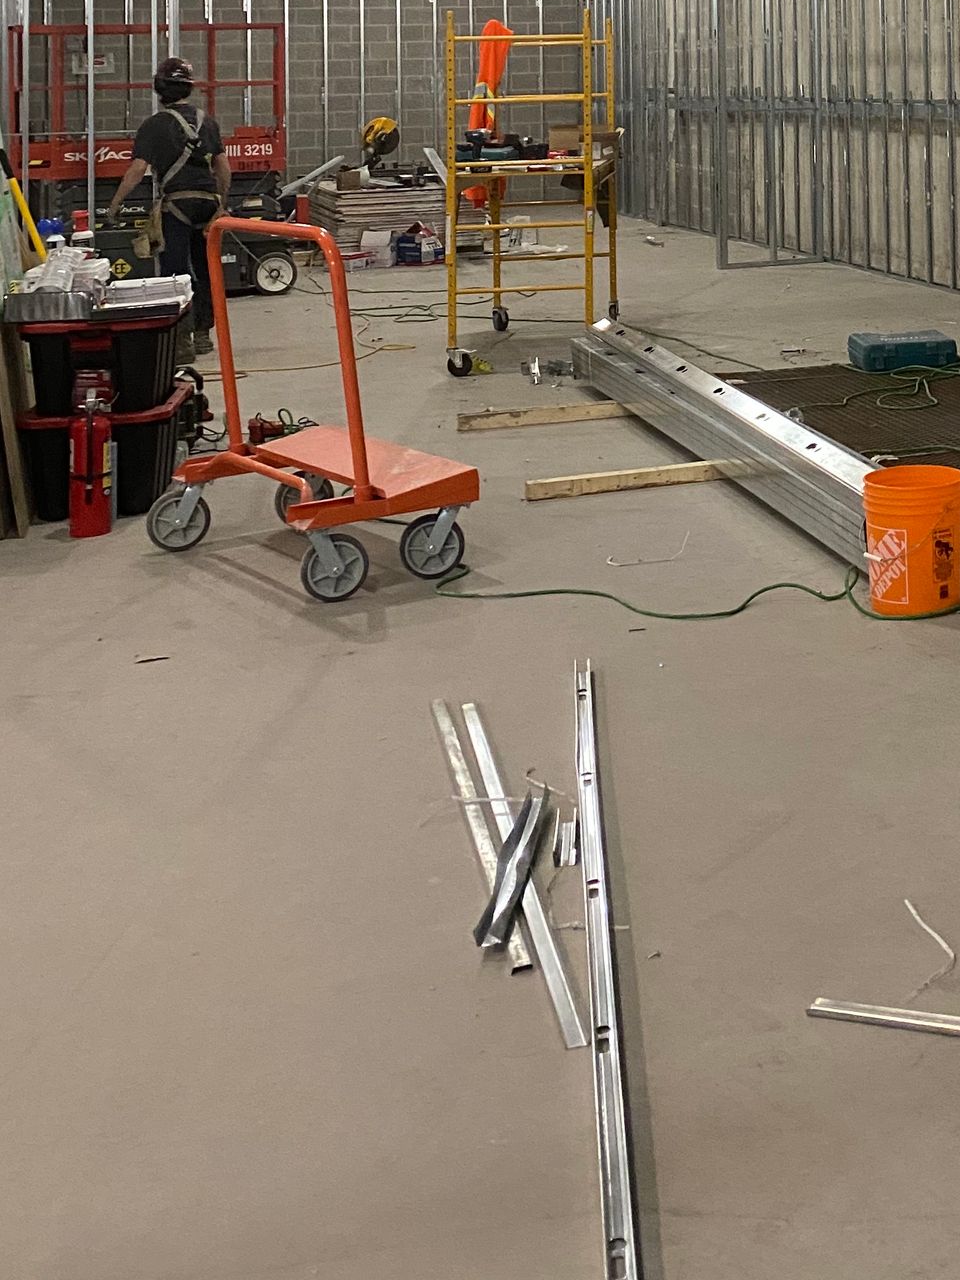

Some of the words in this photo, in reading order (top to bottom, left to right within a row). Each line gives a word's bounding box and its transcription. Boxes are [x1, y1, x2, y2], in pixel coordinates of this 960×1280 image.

[244, 143, 273, 156] 3219
[114, 263, 127, 274] EE
[874, 557, 906, 599] DEPOT
